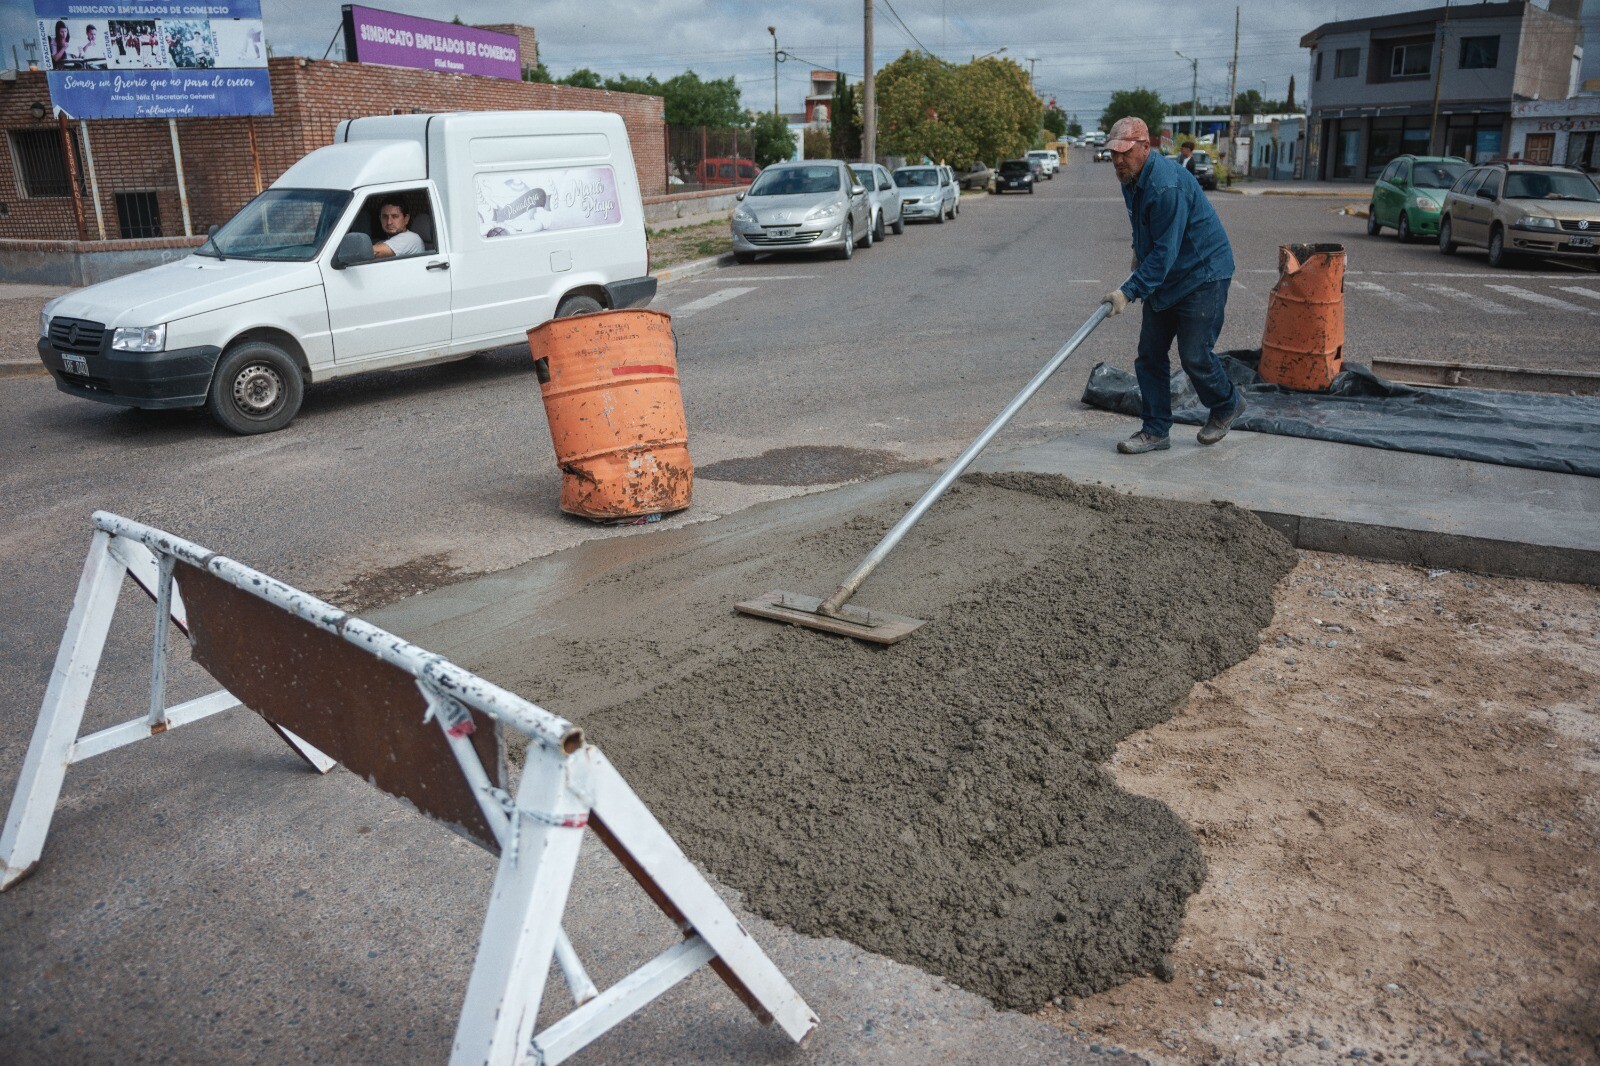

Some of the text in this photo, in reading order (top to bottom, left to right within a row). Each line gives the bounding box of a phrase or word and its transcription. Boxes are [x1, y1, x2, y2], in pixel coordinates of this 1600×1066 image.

[68, 5, 229, 14] SINDICATO EMPLEADOS DE COMERCIO
[104, 31, 113, 58] CULTURA
[360, 24, 516, 62] SINDICATO EMPLEADOS DE COMERCIO
[64, 75, 96, 89] Somos
[114, 75, 148, 92] Gremio
[150, 79, 167, 91] que
[169, 79, 181, 87] no
[183, 79, 209, 91] para
[211, 75, 224, 87] de
[226, 78, 255, 87] crecer
[177, 104, 194, 114] vale!
[581, 195, 616, 221] Playa
